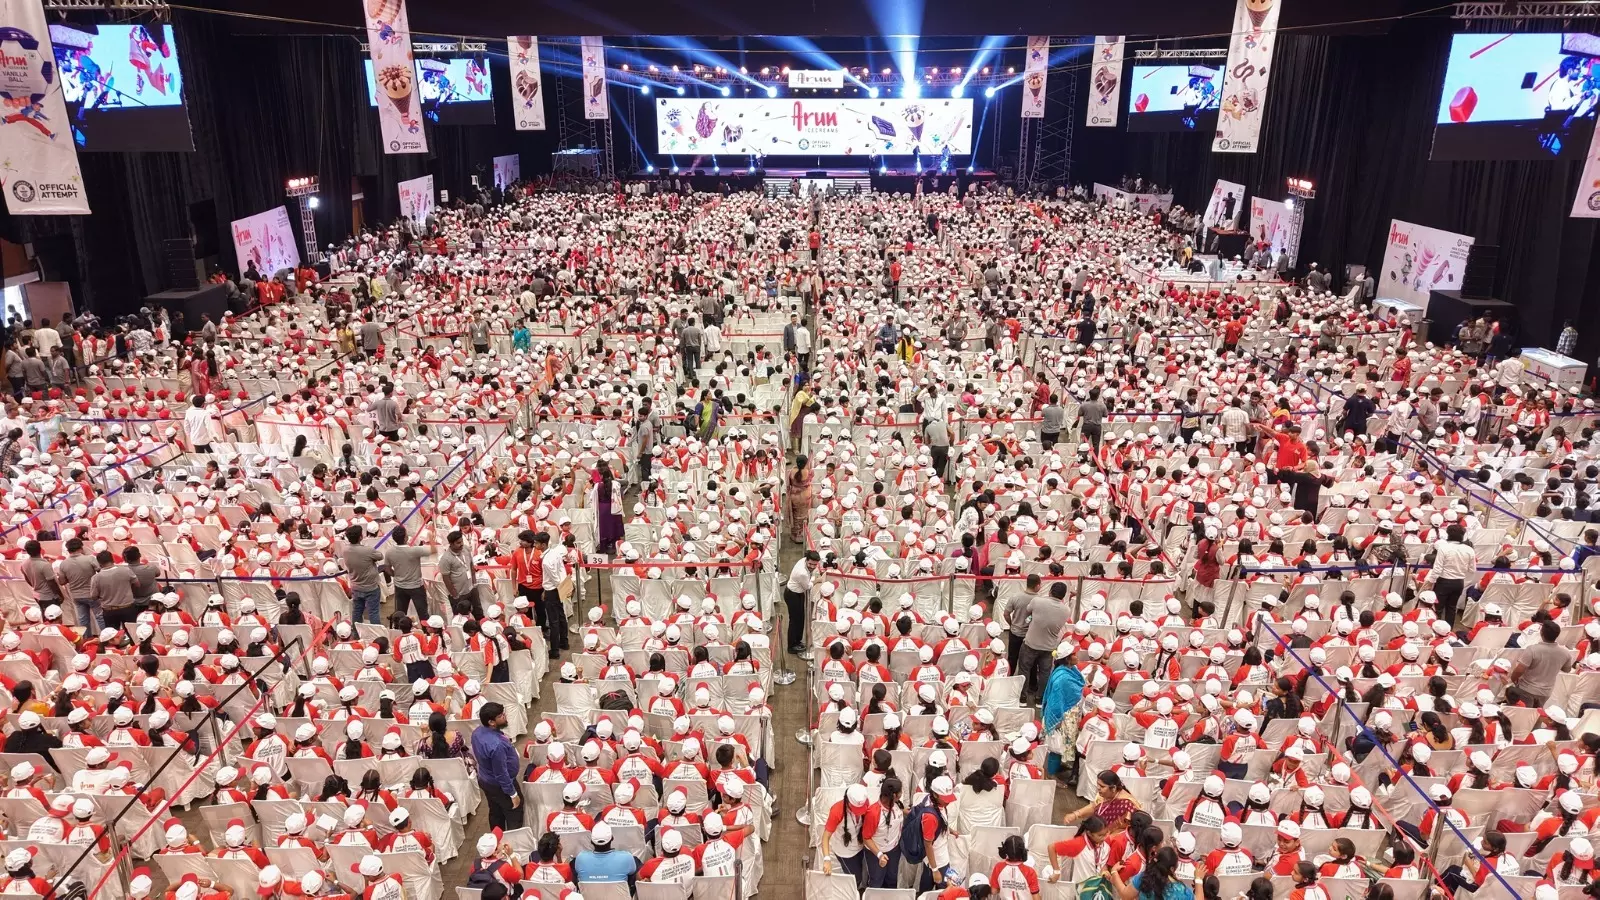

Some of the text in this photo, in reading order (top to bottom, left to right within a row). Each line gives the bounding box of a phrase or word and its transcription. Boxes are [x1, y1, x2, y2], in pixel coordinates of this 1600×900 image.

[797, 73, 832, 84] Arun
[791, 101, 837, 131] Arun
[234, 225, 252, 246] Arun
[1390, 223, 1409, 245] Arun
[80, 782, 95, 791] Arun
